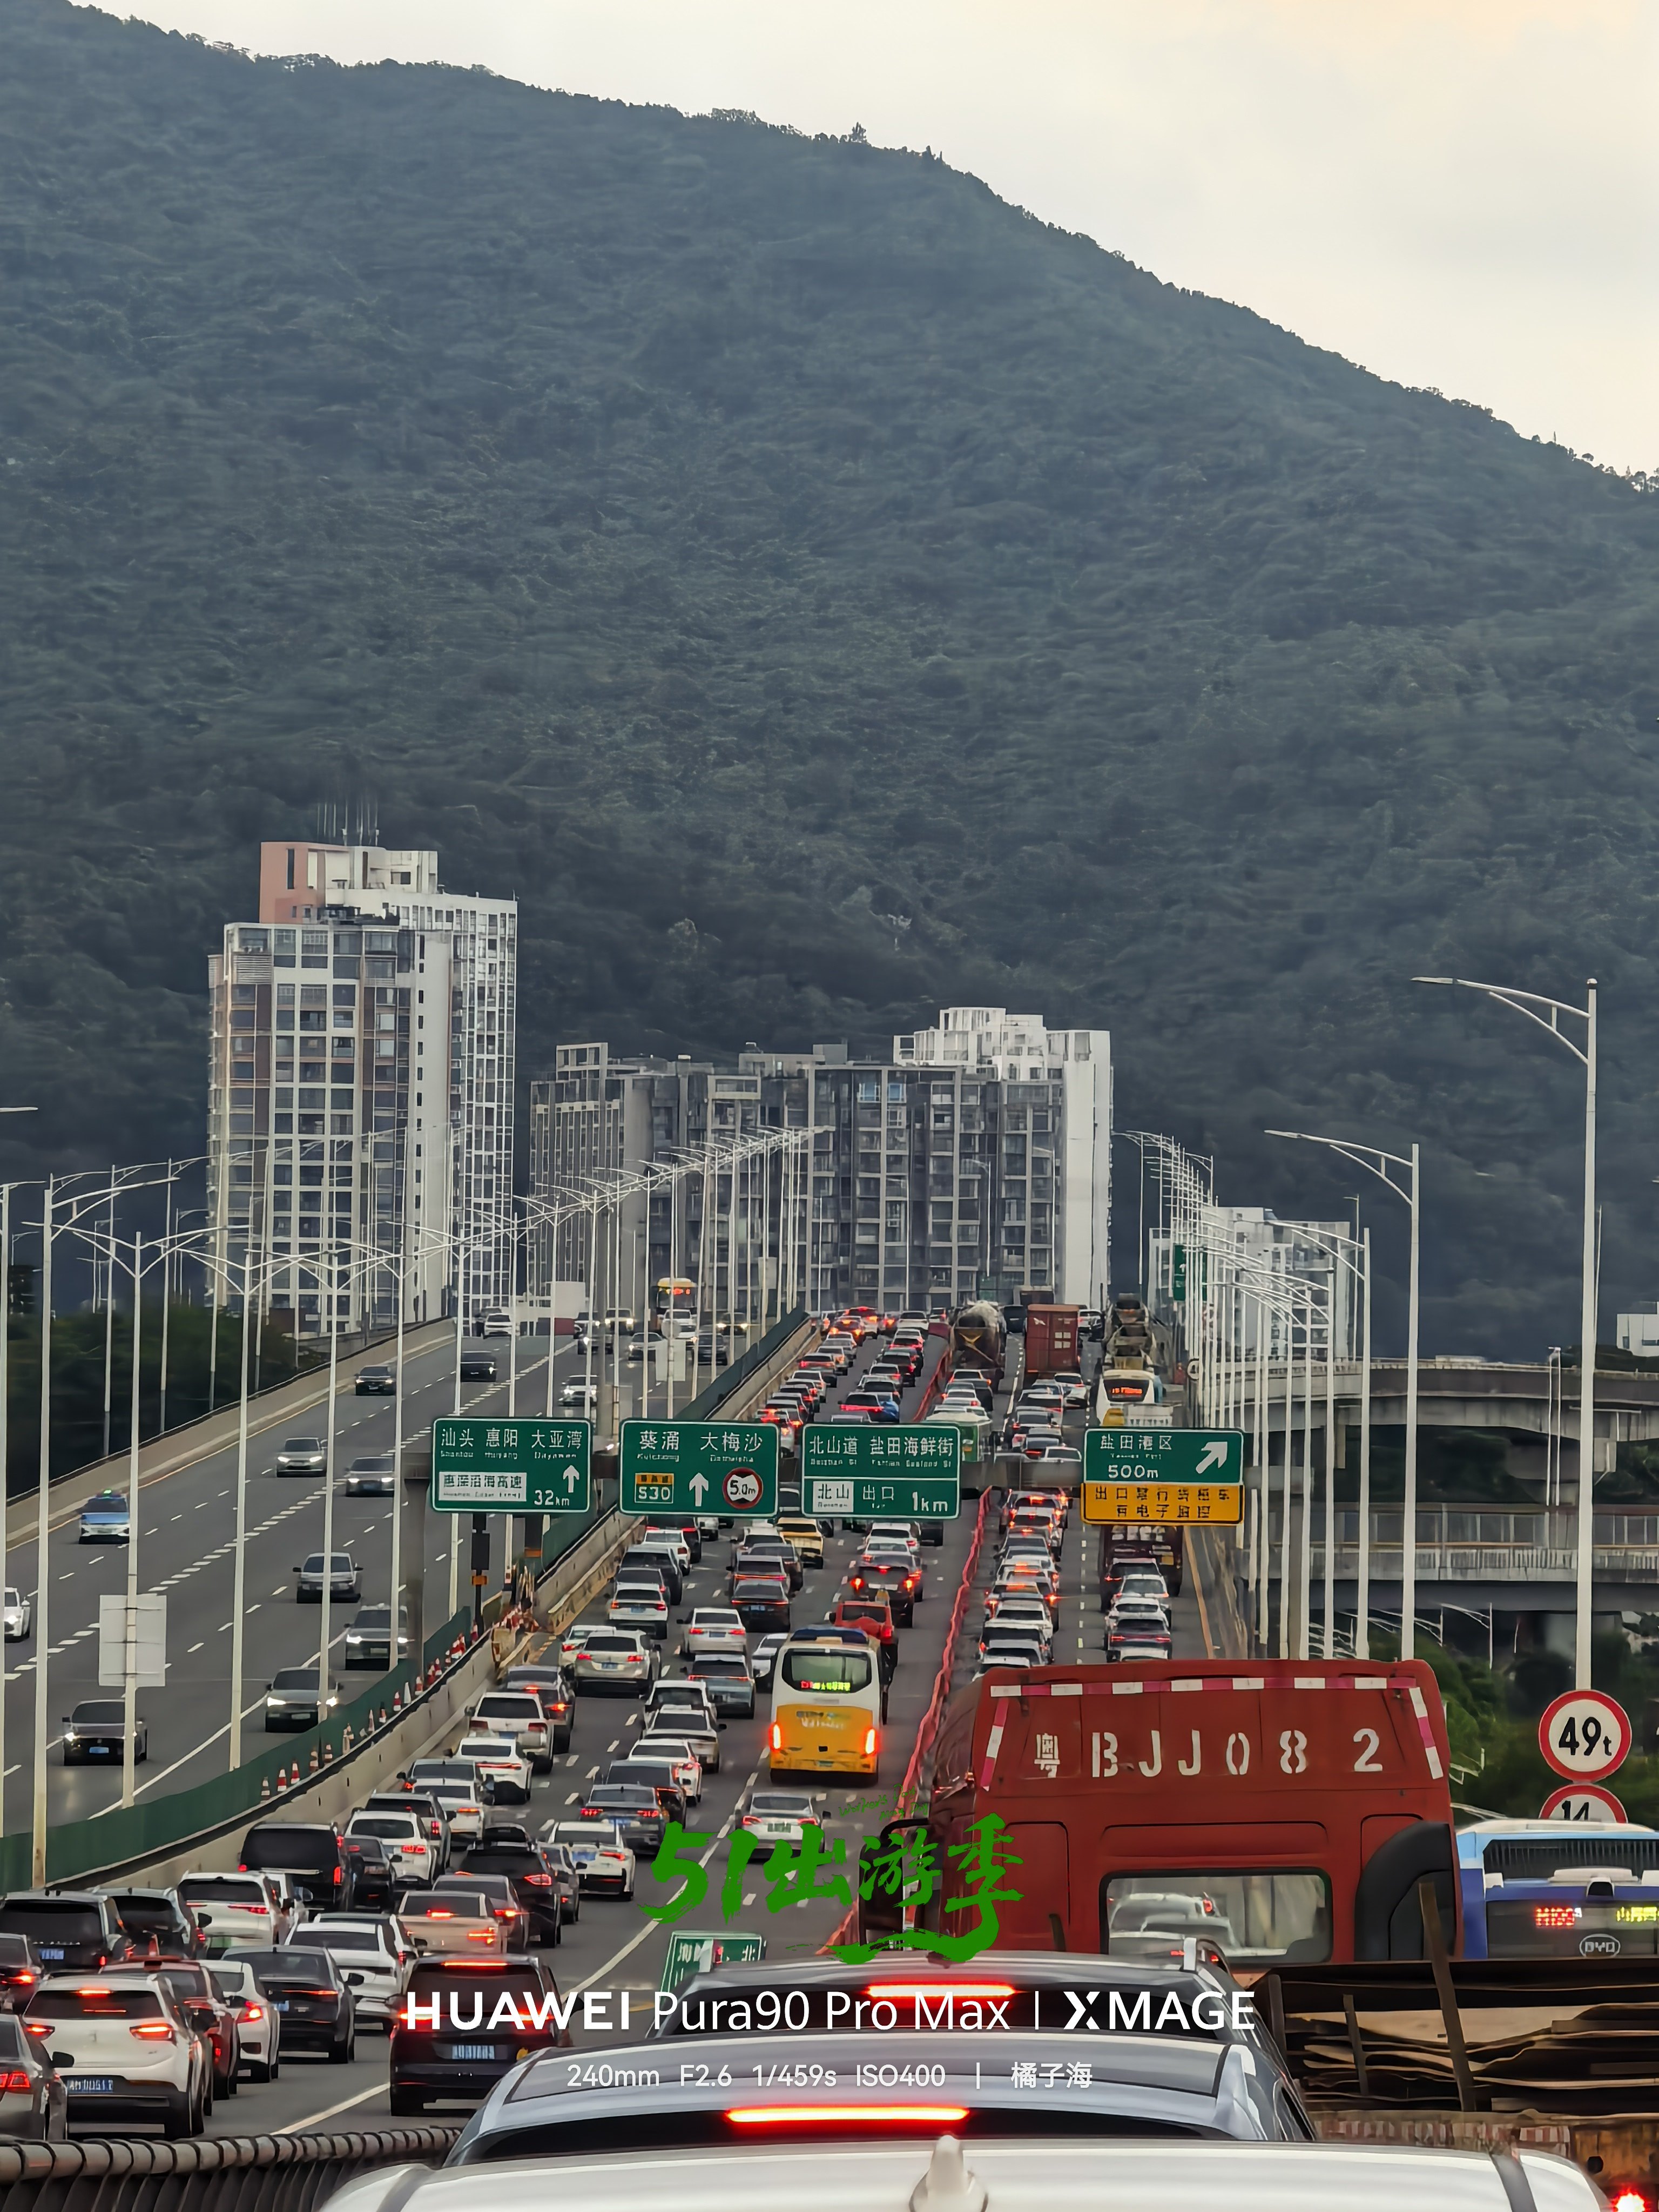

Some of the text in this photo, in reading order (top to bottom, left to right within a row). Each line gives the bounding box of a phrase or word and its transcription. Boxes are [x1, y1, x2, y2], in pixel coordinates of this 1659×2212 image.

[441, 1427, 582, 1449] 汕头 惠阳 大亚湾
[639, 1430, 763, 1452] 葵涌 大梅沙
[809, 1435, 953, 1456] 北山道 盐田海鲜街
[1108, 1464, 1159, 1479] 500m
[534, 1489, 570, 1506] 32km
[638, 1486, 671, 1500] S30
[730, 1480, 756, 1495] 5.0m
[818, 1483, 948, 1512] 北山 出口 1km
[1558, 1716, 1613, 1756] 49t
